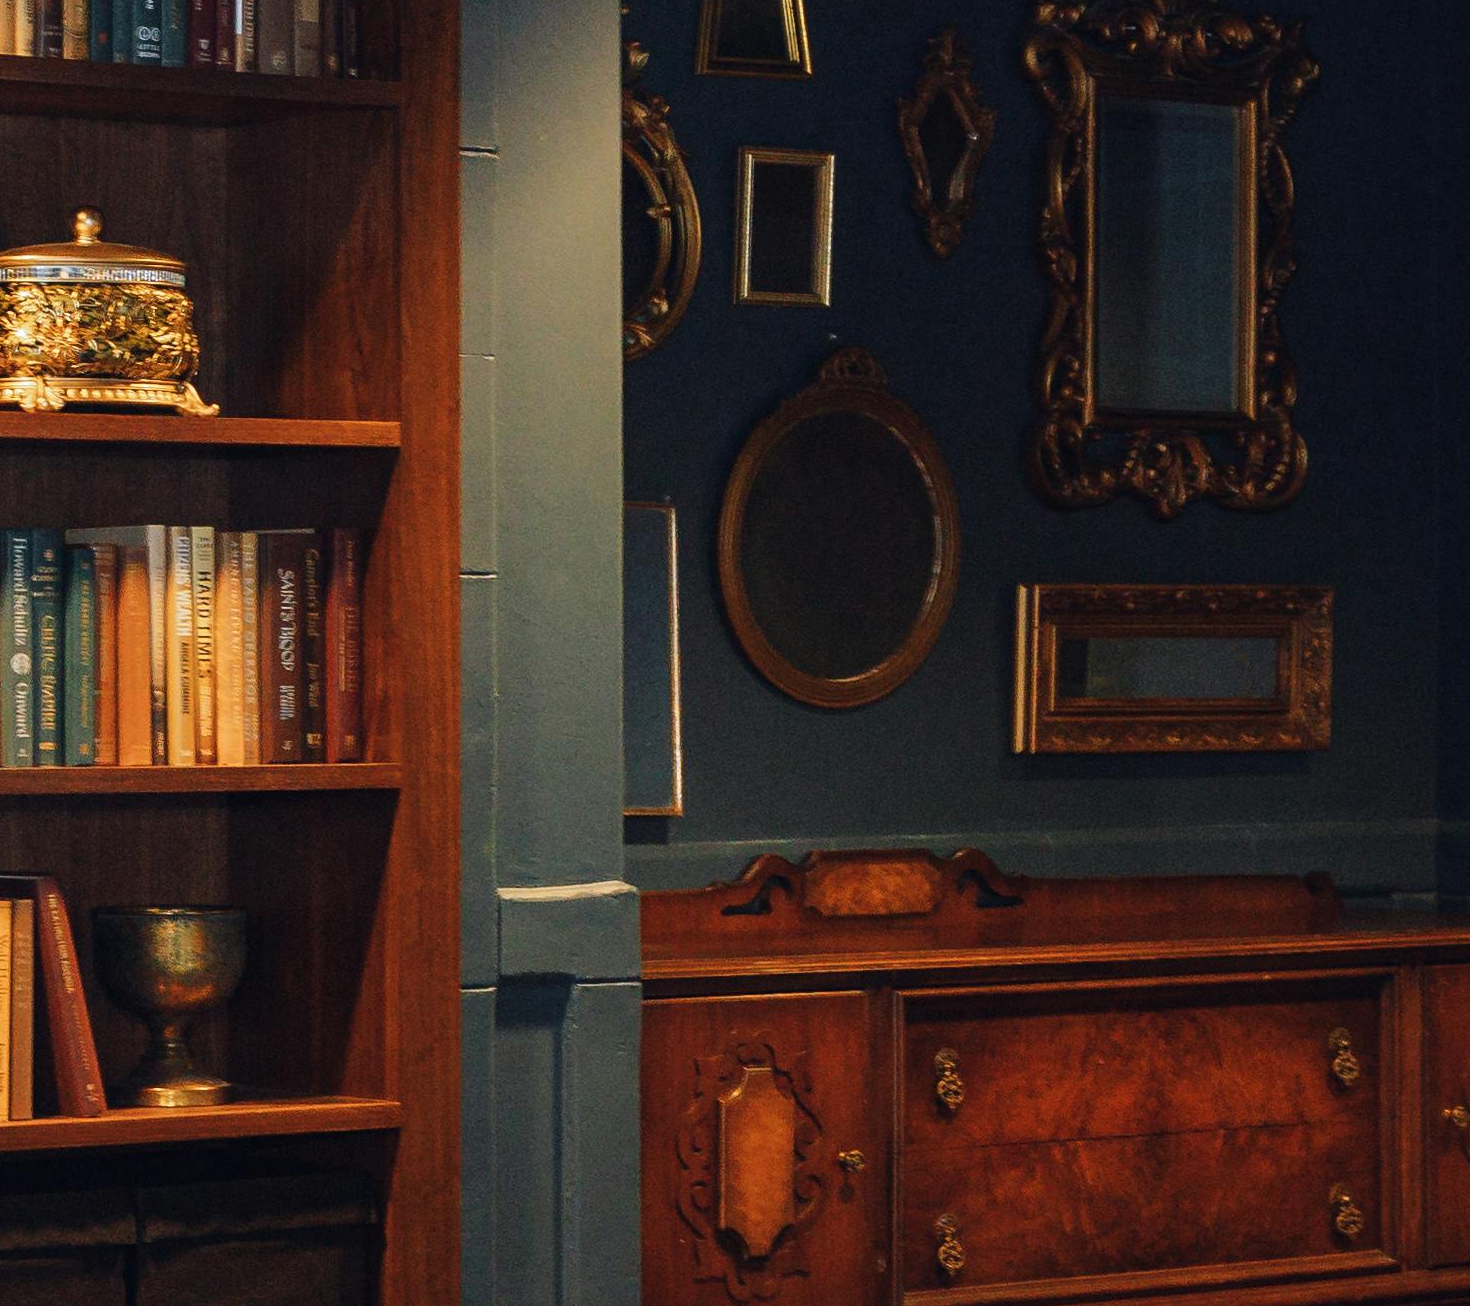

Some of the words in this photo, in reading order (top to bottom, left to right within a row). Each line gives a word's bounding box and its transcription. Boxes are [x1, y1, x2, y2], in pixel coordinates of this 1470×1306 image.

[13, 538, 27, 592] Howard
[14, 595, 27, 646] Schultz
[199, 571, 211, 618] HARD
[15, 682, 29, 738] Onward
